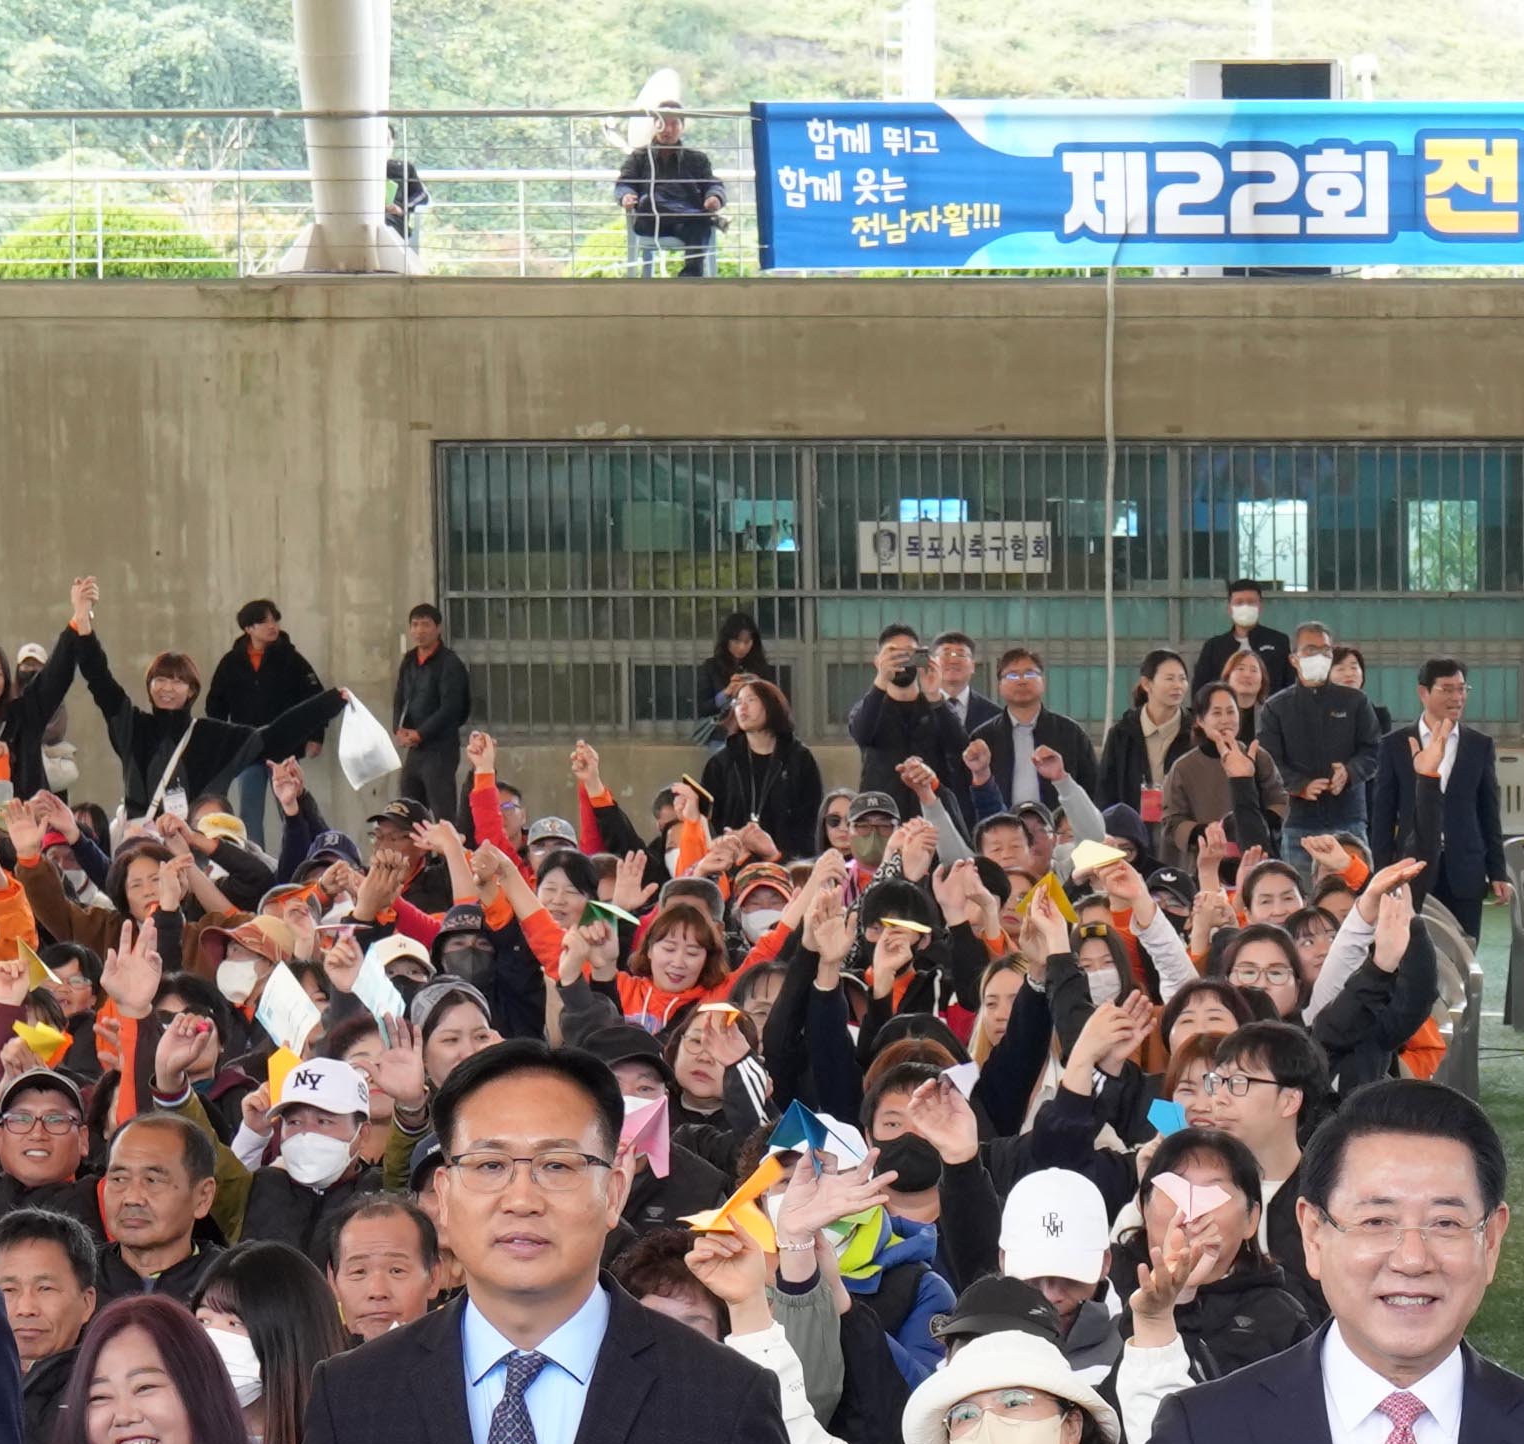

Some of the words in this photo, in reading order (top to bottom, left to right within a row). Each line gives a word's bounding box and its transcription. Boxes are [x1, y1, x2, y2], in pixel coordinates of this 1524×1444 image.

[807, 118, 871, 160] 함께
[882, 126, 939, 156] 뛰고
[778, 166, 841, 208] 함께
[853, 168, 907, 205] 웃는
[1062, 149, 1388, 234] 제22회
[851, 202, 1000, 247] 전남자활!!!
[292, 1068, 325, 1091] NY
